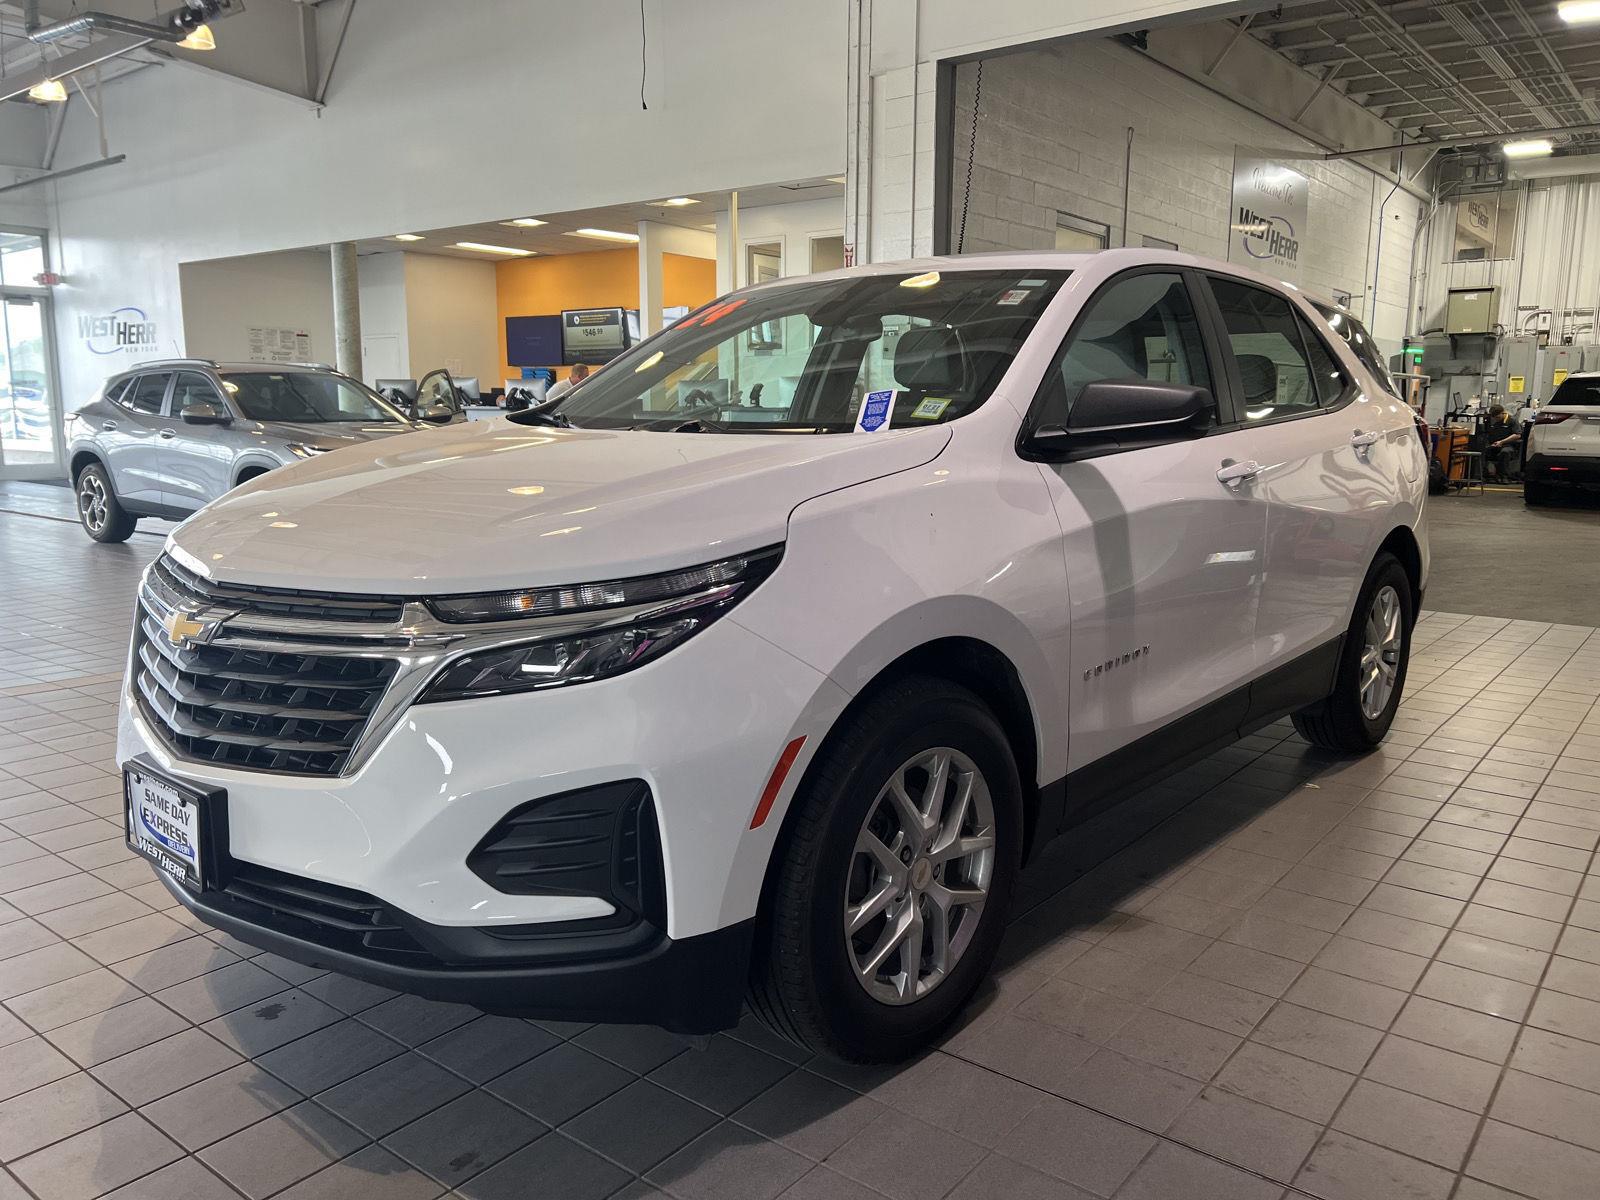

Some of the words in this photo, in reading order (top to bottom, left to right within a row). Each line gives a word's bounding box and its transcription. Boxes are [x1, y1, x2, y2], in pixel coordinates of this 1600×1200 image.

[1239, 207, 1273, 242] WEST
[1269, 229, 1299, 261] HERR
[78, 316, 116, 338] WEST
[116, 322, 157, 345] HERR
[143, 807, 188, 847] EXPRESS
[144, 788, 170, 815] SAME
[171, 803, 191, 826] DAY
[139, 836, 163, 860] WEST
[161, 855, 186, 880] HERR
